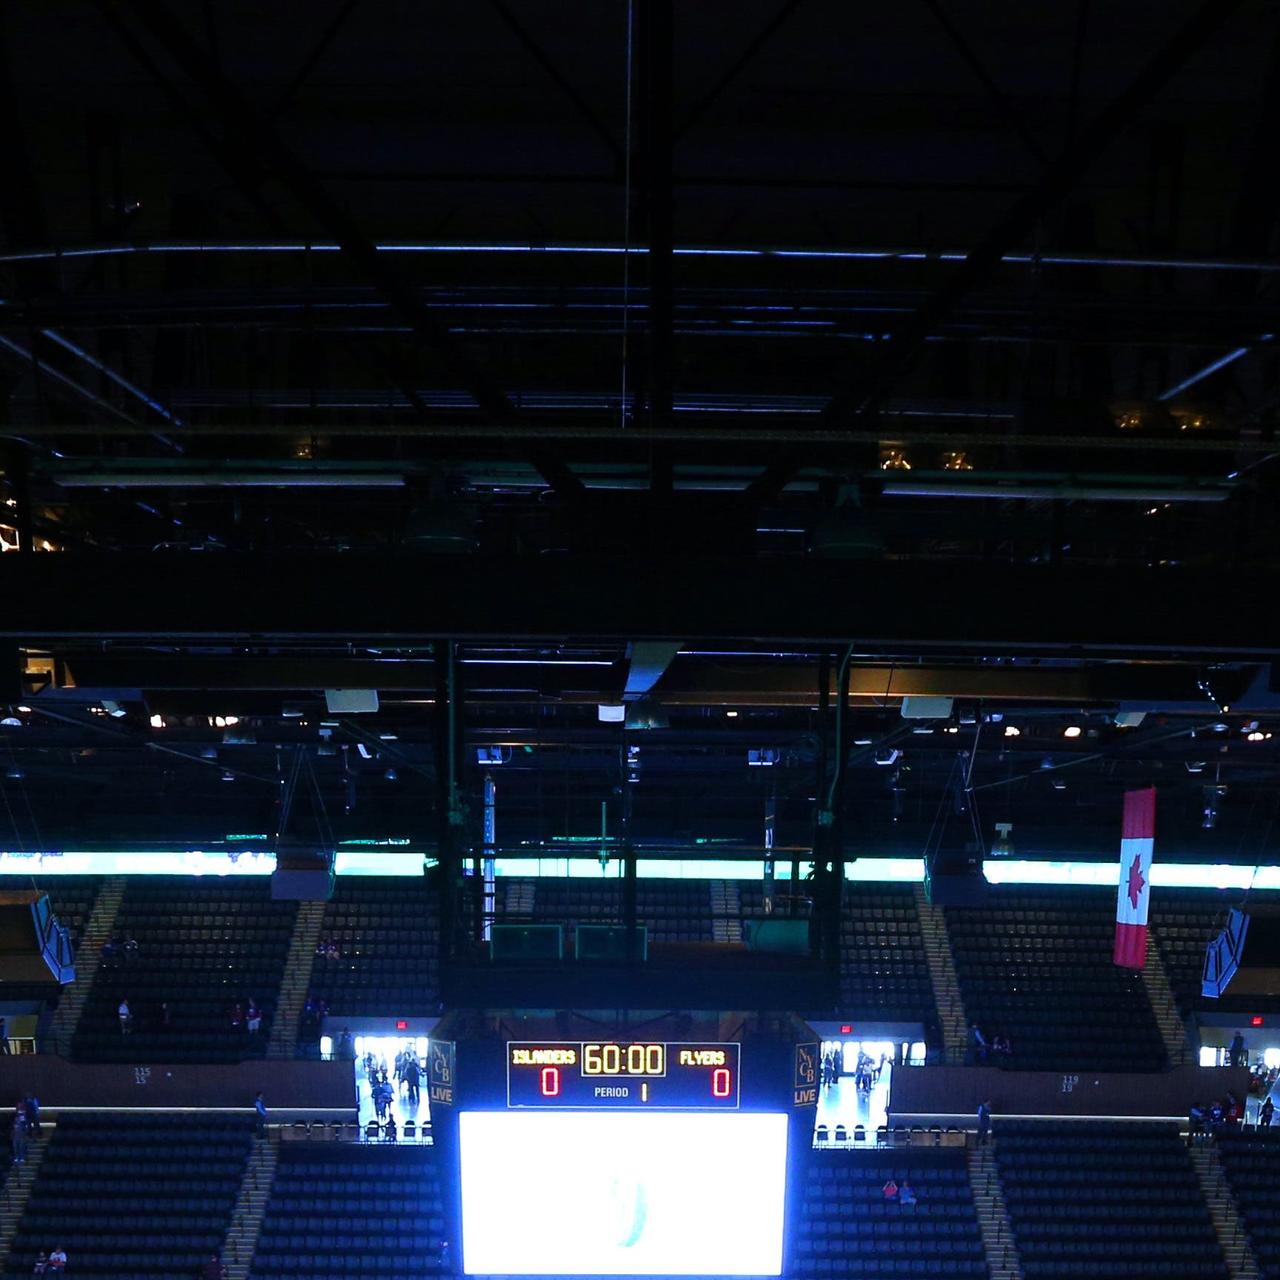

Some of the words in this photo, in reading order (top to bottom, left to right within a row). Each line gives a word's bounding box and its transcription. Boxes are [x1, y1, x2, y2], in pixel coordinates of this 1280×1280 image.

[512, 1049, 576, 1064] ISLANDERS
[585, 1045, 663, 1074] 60:00
[679, 1050, 725, 1065] FLYERS
[542, 1068, 558, 1095] 0
[713, 1069, 730, 1096] 0
[1063, 1075, 1079, 1085] 119
[431, 1087, 452, 1101] LIVE
[594, 1087, 629, 1097] PERIOD
[641, 1083, 648, 1102] 1
[794, 1089, 816, 1103] LIVE
